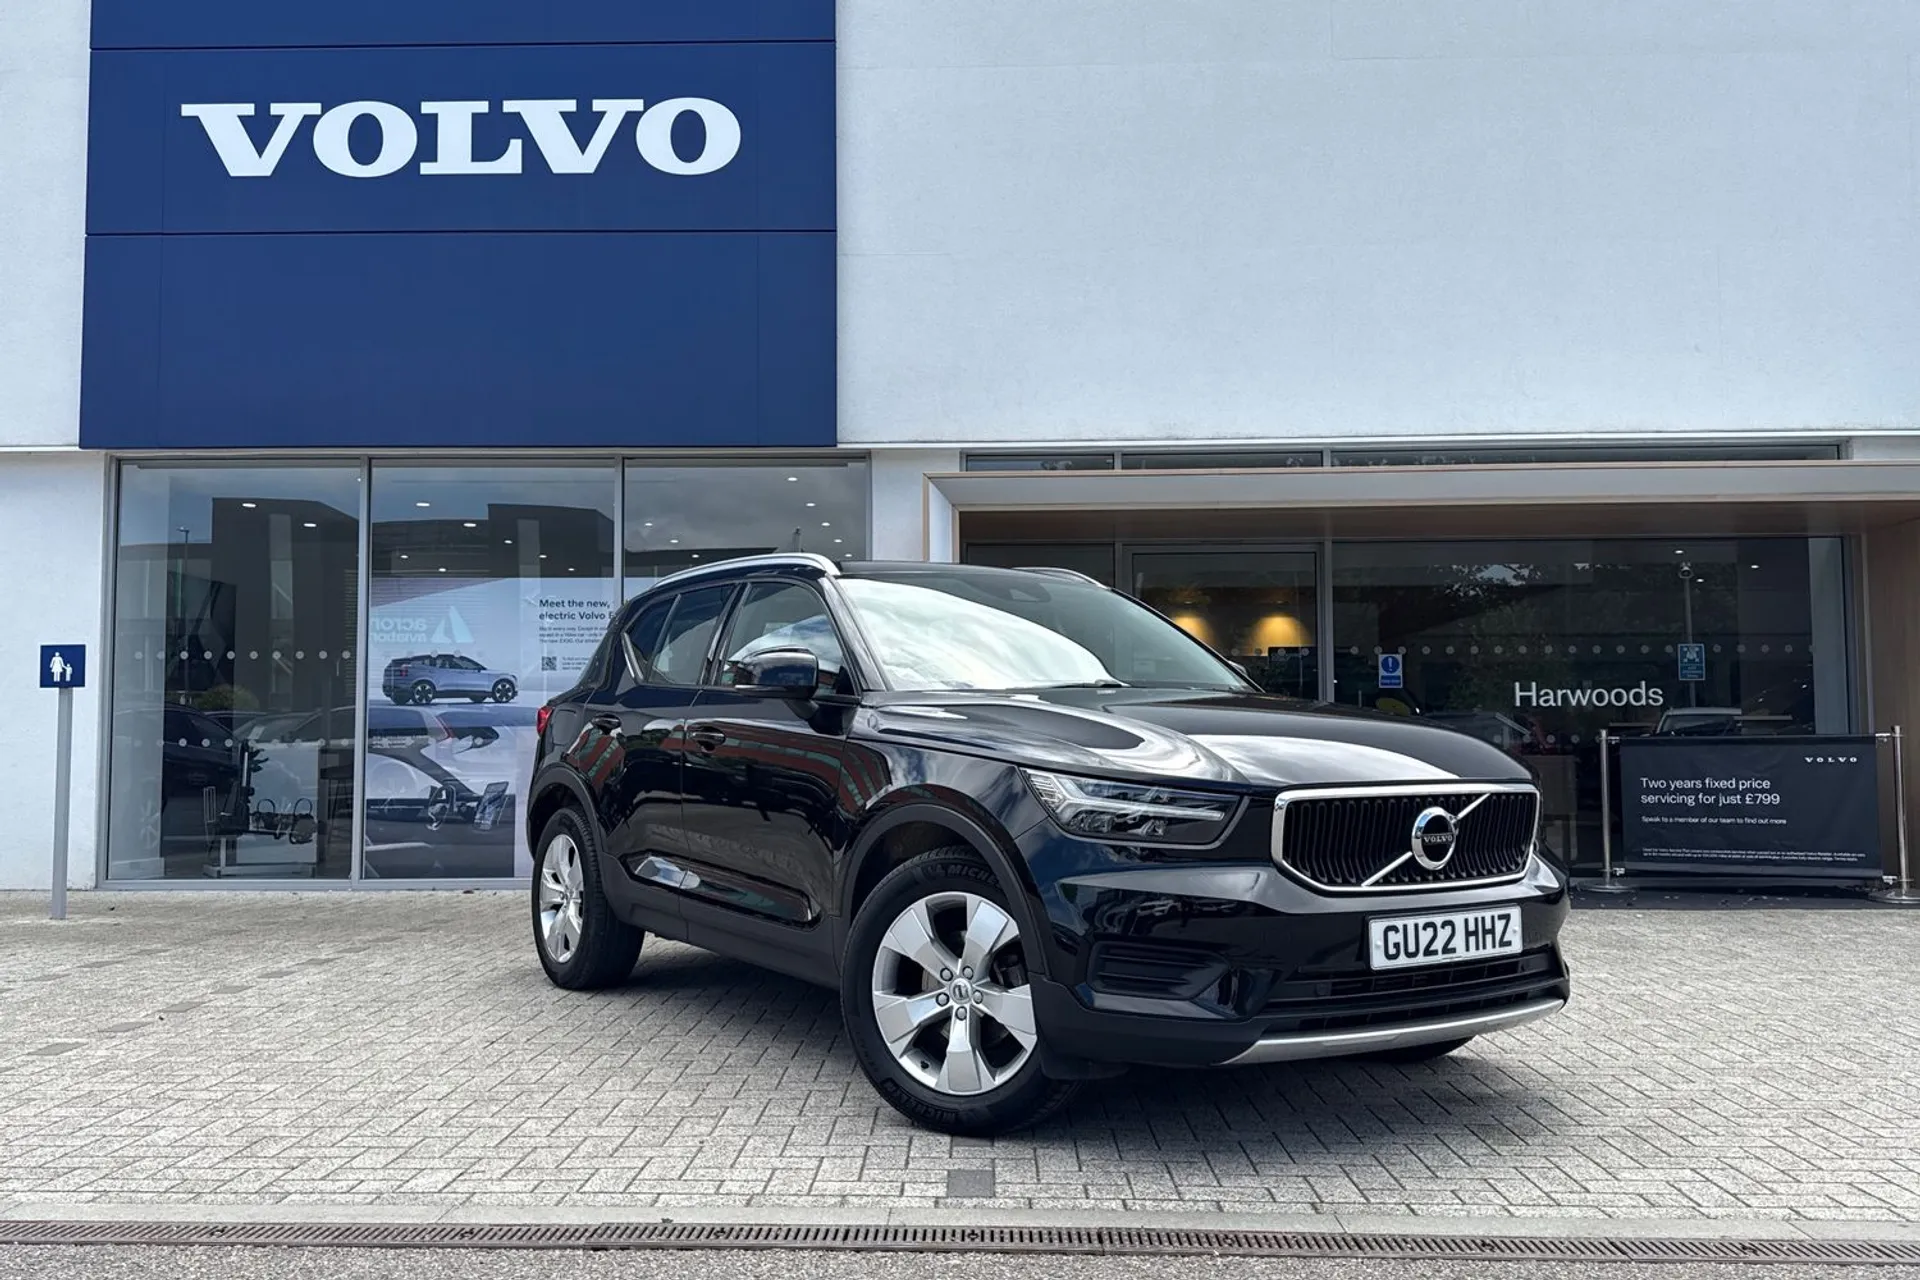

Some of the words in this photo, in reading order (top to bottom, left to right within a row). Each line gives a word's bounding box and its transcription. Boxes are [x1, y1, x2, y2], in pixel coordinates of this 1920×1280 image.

[181, 97, 741, 178] VOLVO
[539, 599, 565, 608] Meet
[567, 599, 584, 608] the
[586, 601, 610, 609] new,
[539, 611, 576, 620] electric
[578, 611, 606, 620] Volvo
[1513, 681, 1664, 707] Harwoods
[1640, 777, 1667, 789] Two
[1669, 779, 1703, 791] years
[1705, 777, 1736, 789] fixed
[1739, 778, 1771, 791] price
[1640, 792, 1696, 807] servicing
[1698, 792, 1717, 804] for
[1718, 792, 1742, 807] just
[1745, 793, 1781, 805] £799
[1641, 815, 1660, 824] Speak
[1674, 816, 1699, 824] member
[1700, 816, 1708, 824] of
[1744, 816, 1757, 825] find
[1758, 817, 1769, 825] out
[1423, 835, 1453, 843] VOLVO
[1383, 920, 1457, 961] GU22
[1463, 913, 1513, 952] HHZ
